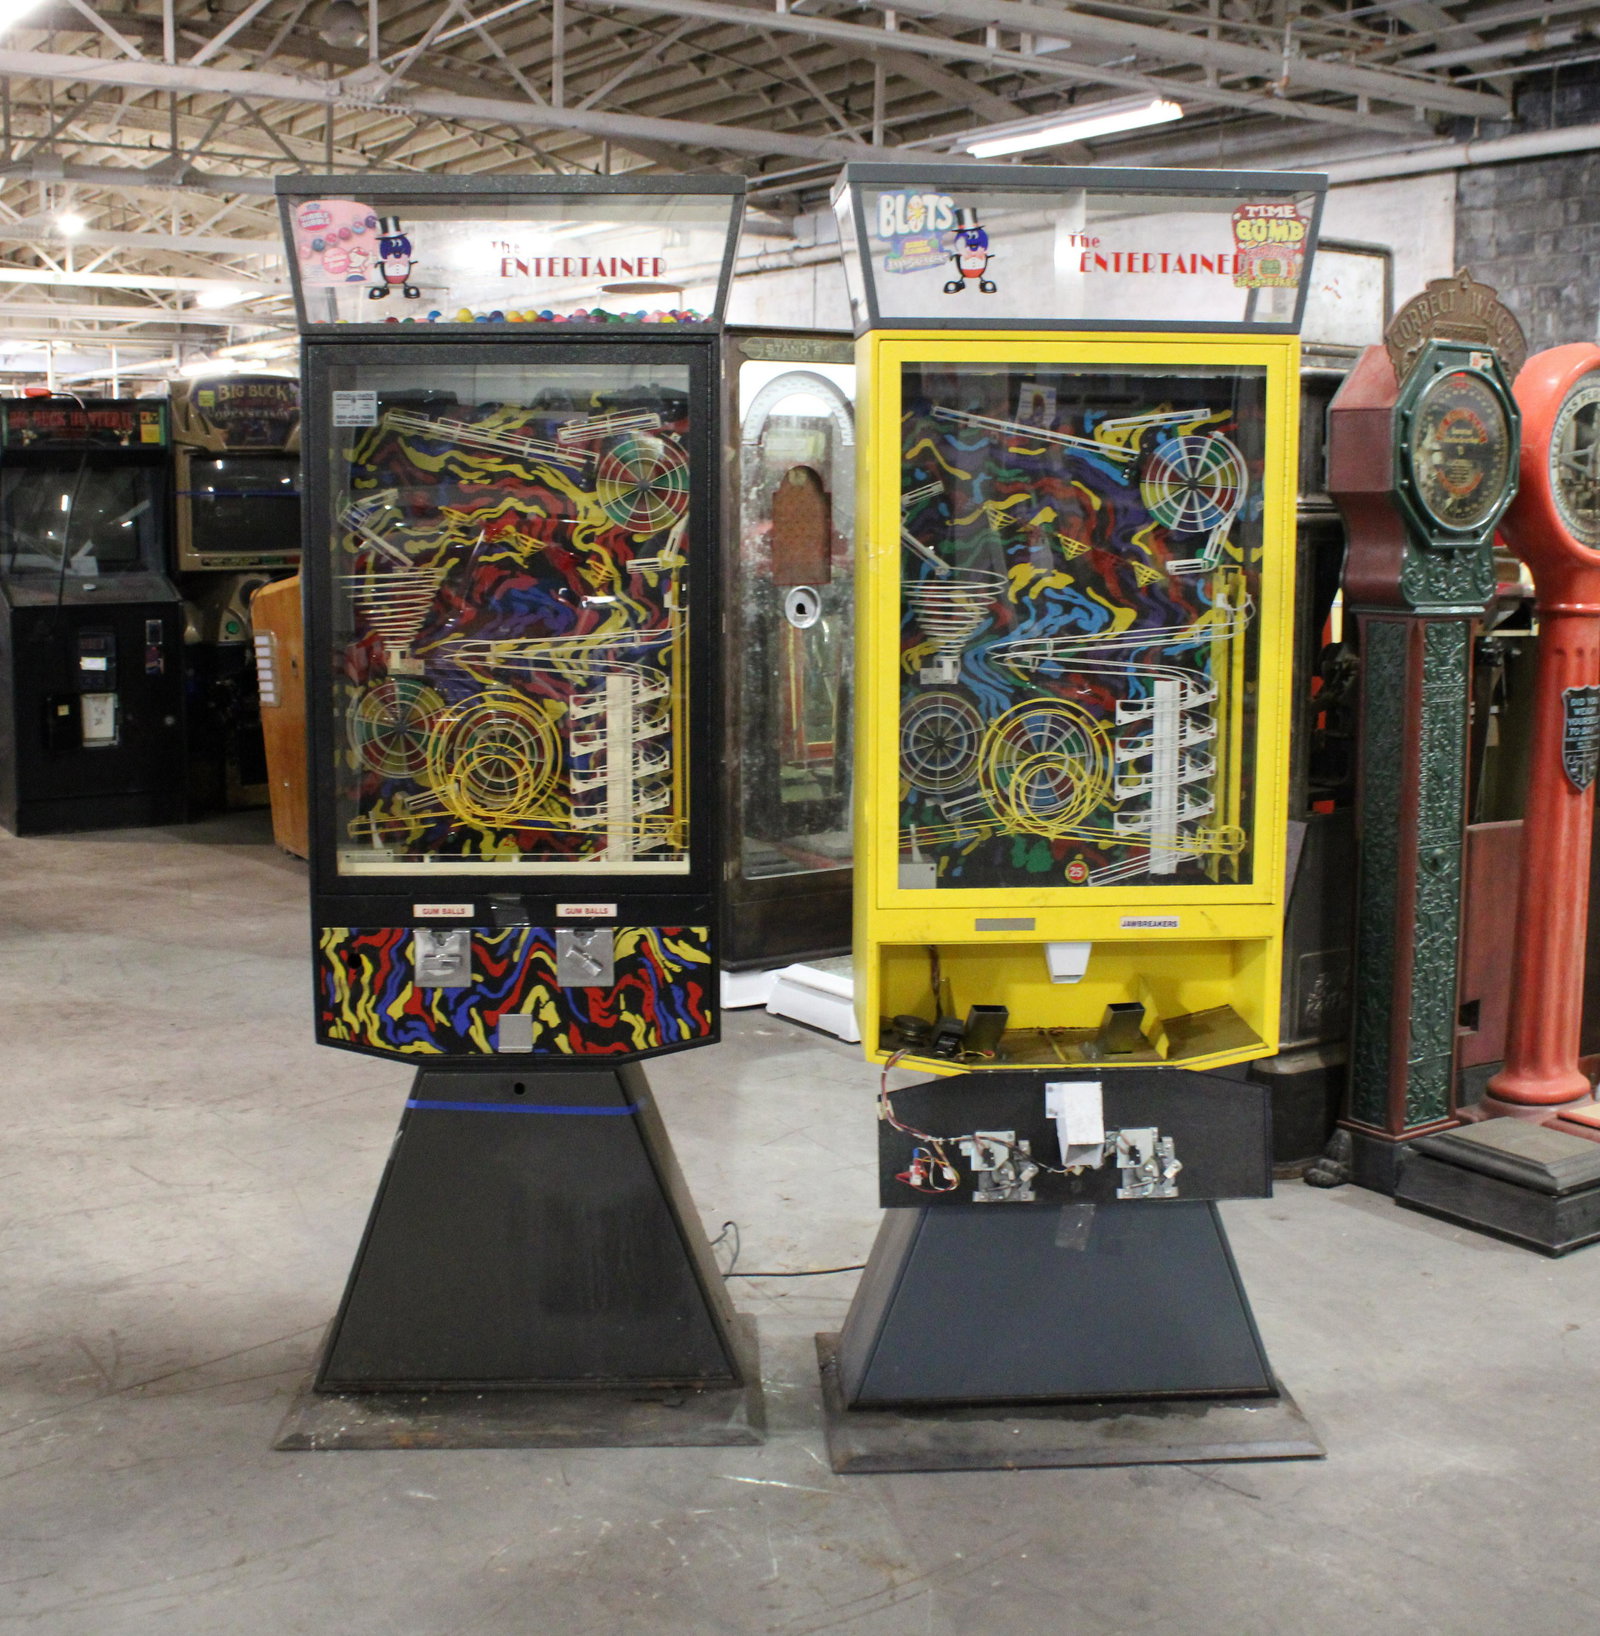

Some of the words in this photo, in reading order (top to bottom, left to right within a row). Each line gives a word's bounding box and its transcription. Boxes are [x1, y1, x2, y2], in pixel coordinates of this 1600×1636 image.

[879, 194, 954, 239] BLOTS
[1244, 205, 1298, 219] TIME
[1235, 218, 1306, 243] BOMB
[1068, 233, 1101, 249] The
[500, 256, 668, 278] ENTERTAINER
[1391, 288, 1457, 350] CORRECT
[765, 343, 809, 356] STAND
[217, 384, 245, 402] BIG
[248, 384, 289, 402] BUCK
[1121, 920, 1179, 928] JAWBREAKERS
